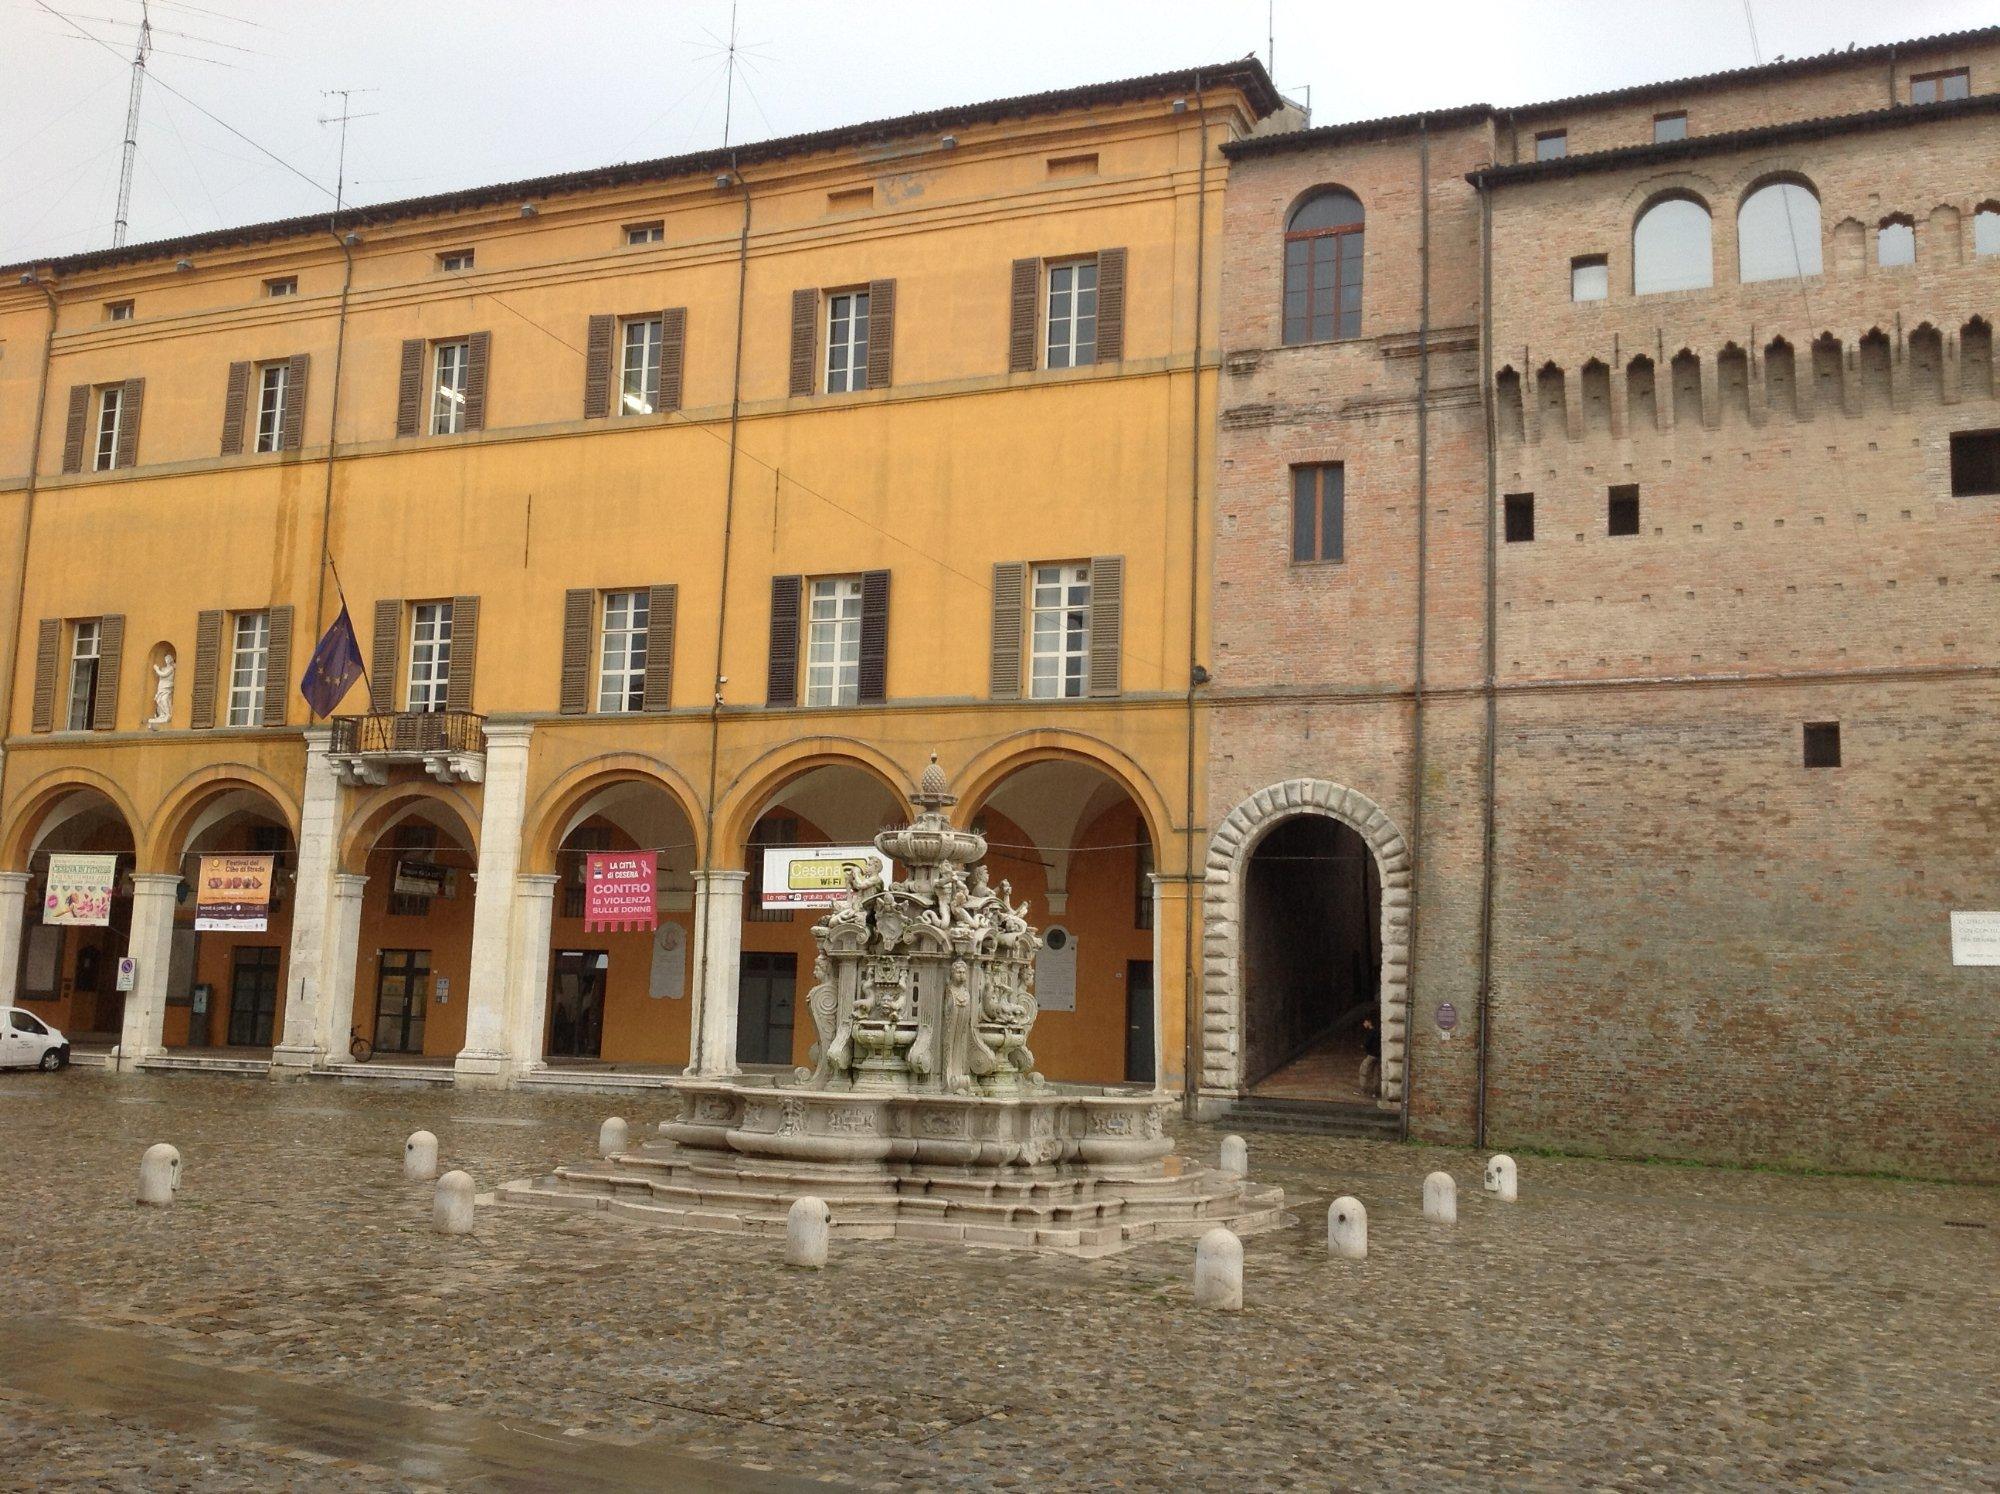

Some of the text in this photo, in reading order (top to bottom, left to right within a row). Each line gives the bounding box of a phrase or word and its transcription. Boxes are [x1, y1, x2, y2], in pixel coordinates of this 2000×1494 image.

[609, 860, 637, 870] LA CITTÀ
[791, 863, 841, 877] Cesena
[615, 871, 639, 879] CESENA
[593, 883, 651, 894] CONTRO
[592, 896, 651, 905] la VIOLENZA
[592, 905, 652, 914] SULLE DONNE
